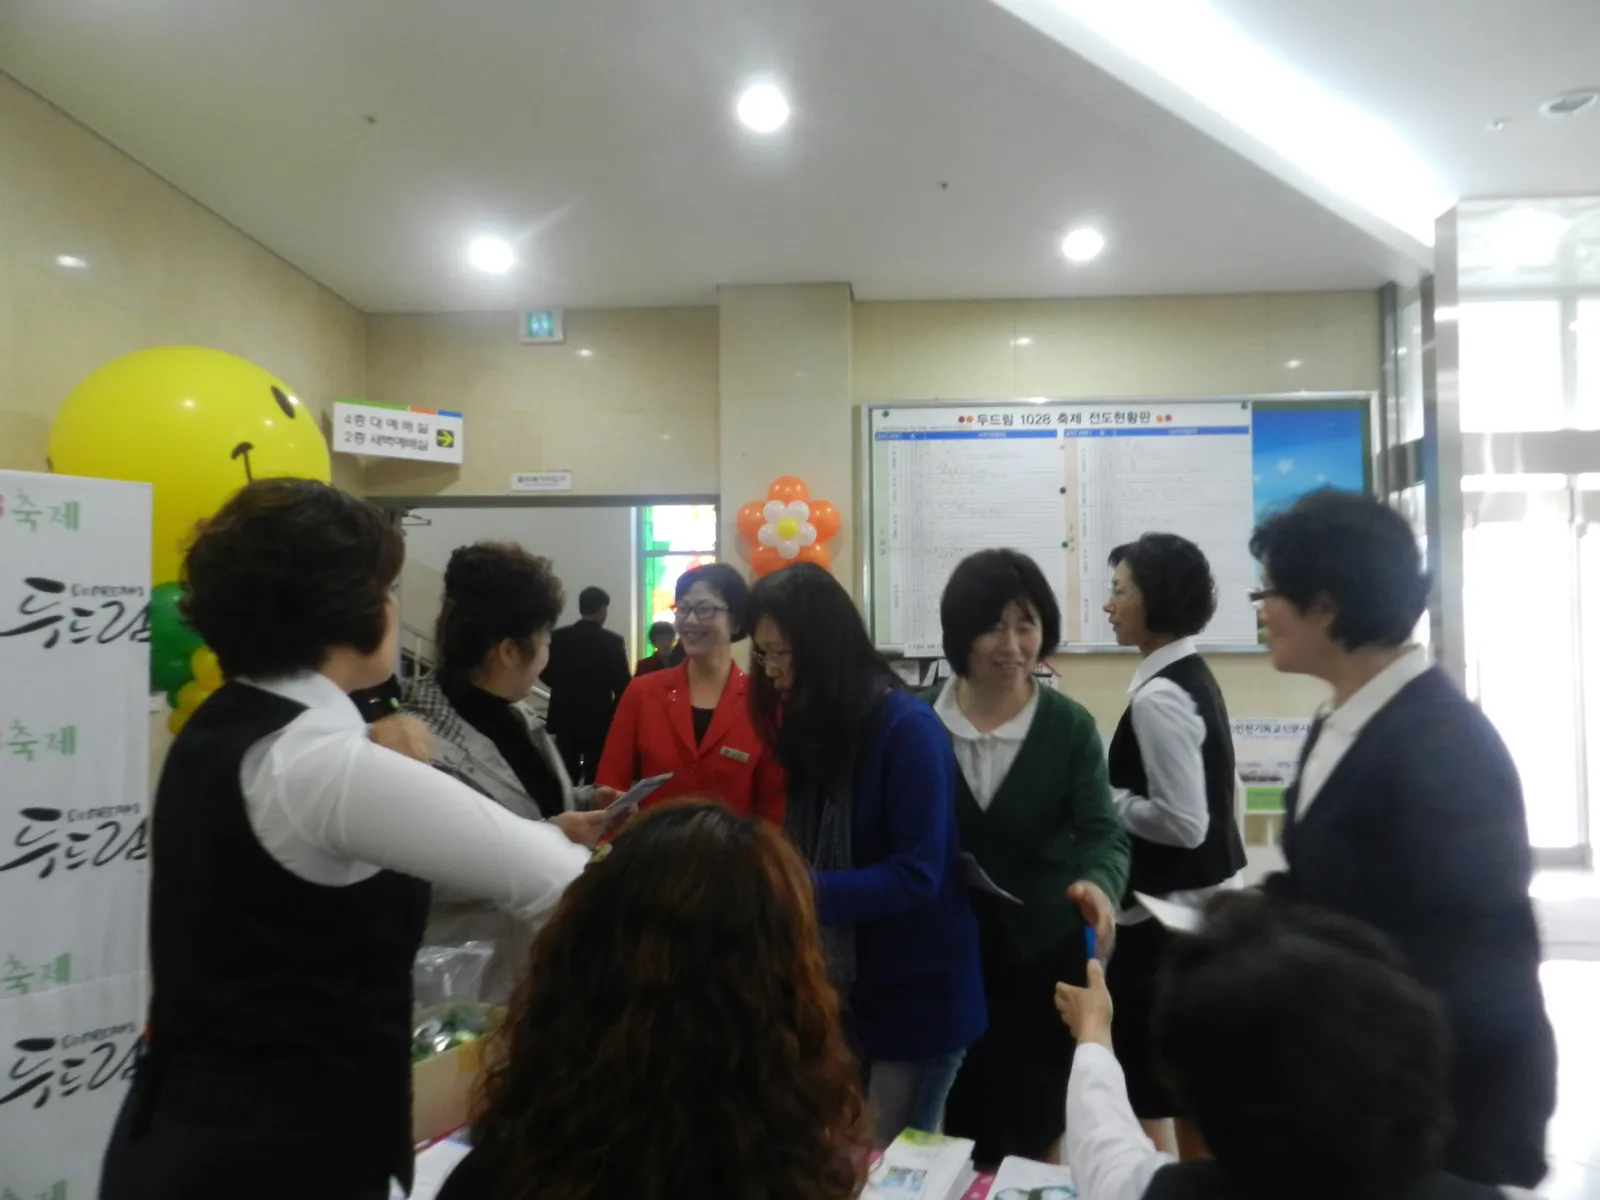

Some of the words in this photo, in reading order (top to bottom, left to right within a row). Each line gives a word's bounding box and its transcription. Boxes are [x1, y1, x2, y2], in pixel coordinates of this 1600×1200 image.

[344, 413, 366, 428] 4층
[976, 413, 1014, 426] 두드림
[1020, 413, 1051, 426] 1028
[1057, 411, 1082, 425] 축제
[344, 431, 366, 446] 2층
[10, 487, 80, 532] 축제
[8, 718, 77, 762] 축제
[1, 953, 72, 994] 축제
